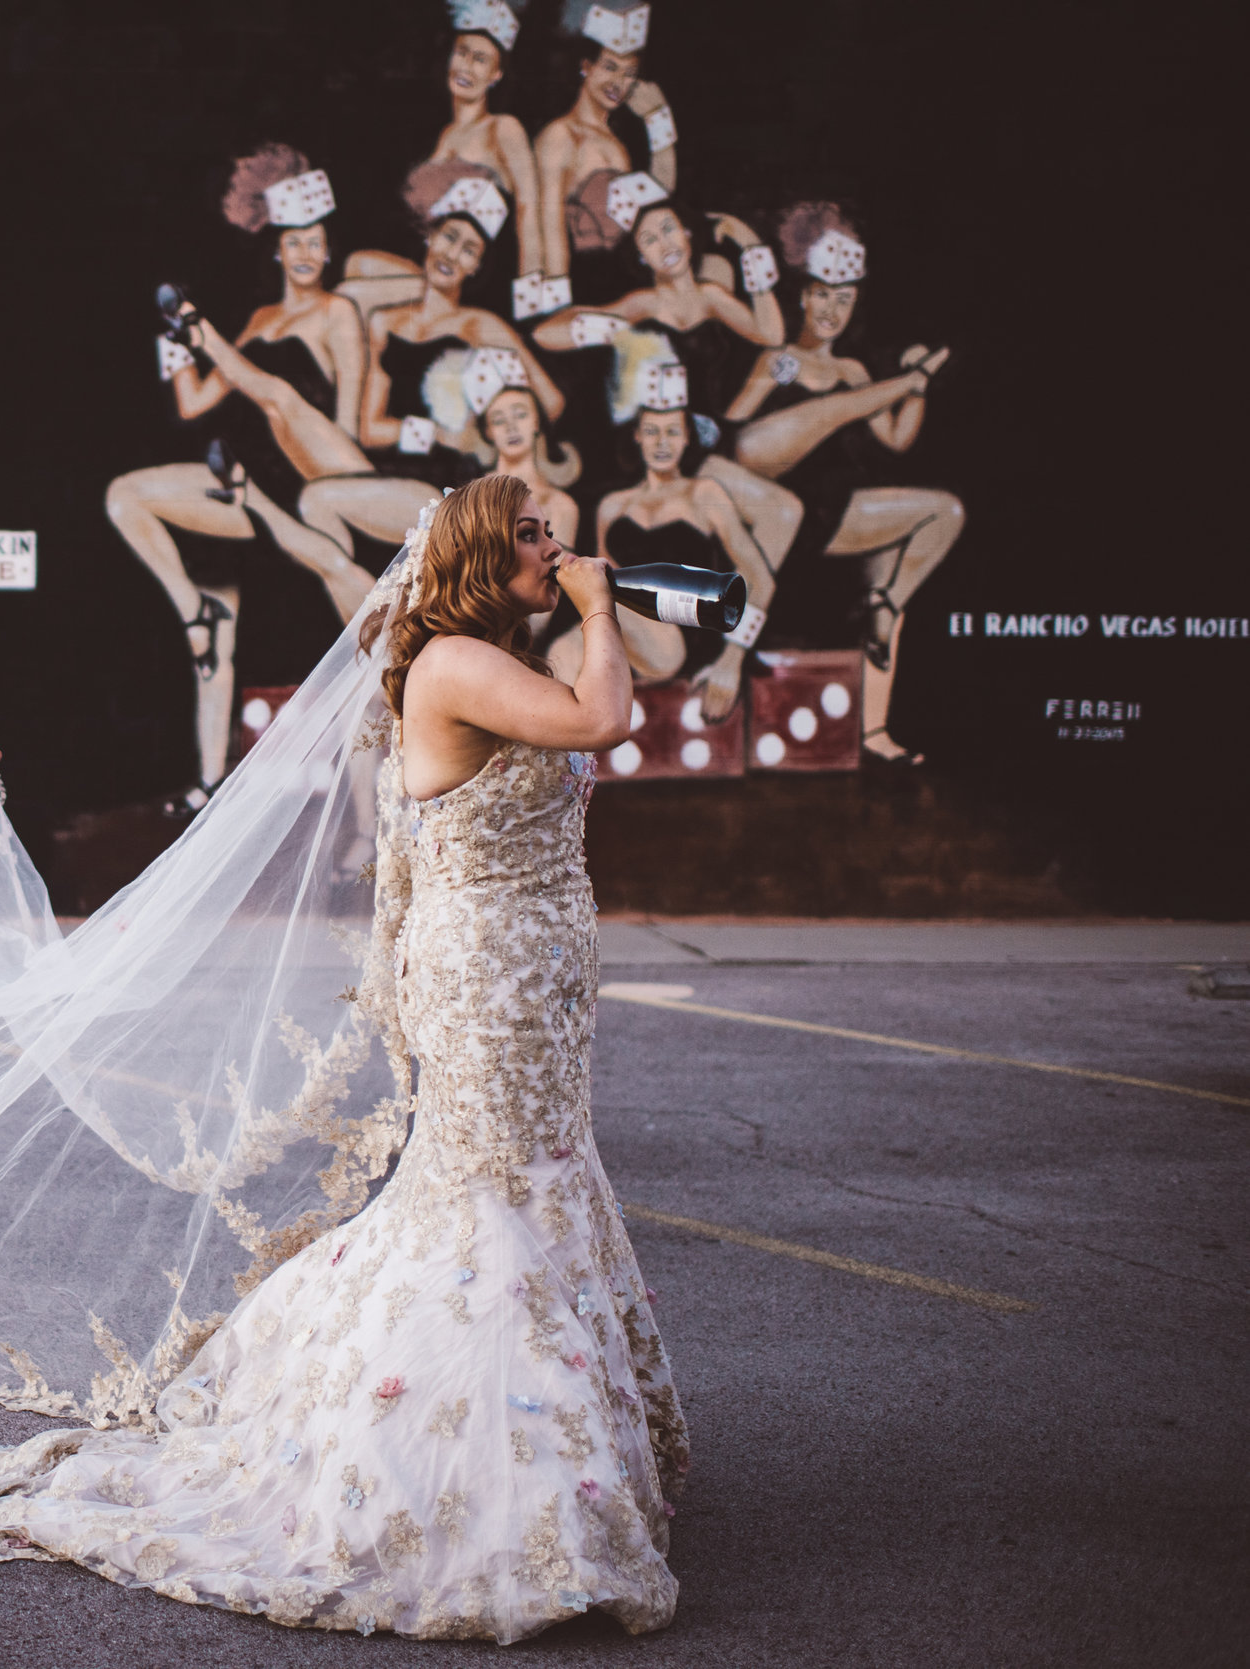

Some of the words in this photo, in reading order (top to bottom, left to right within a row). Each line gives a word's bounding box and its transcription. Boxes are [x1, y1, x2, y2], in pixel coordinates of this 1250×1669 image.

[12, 537, 31, 554] IN
[985, 612, 1089, 637] RANCHO
[1100, 614, 1177, 637] VEGAS
